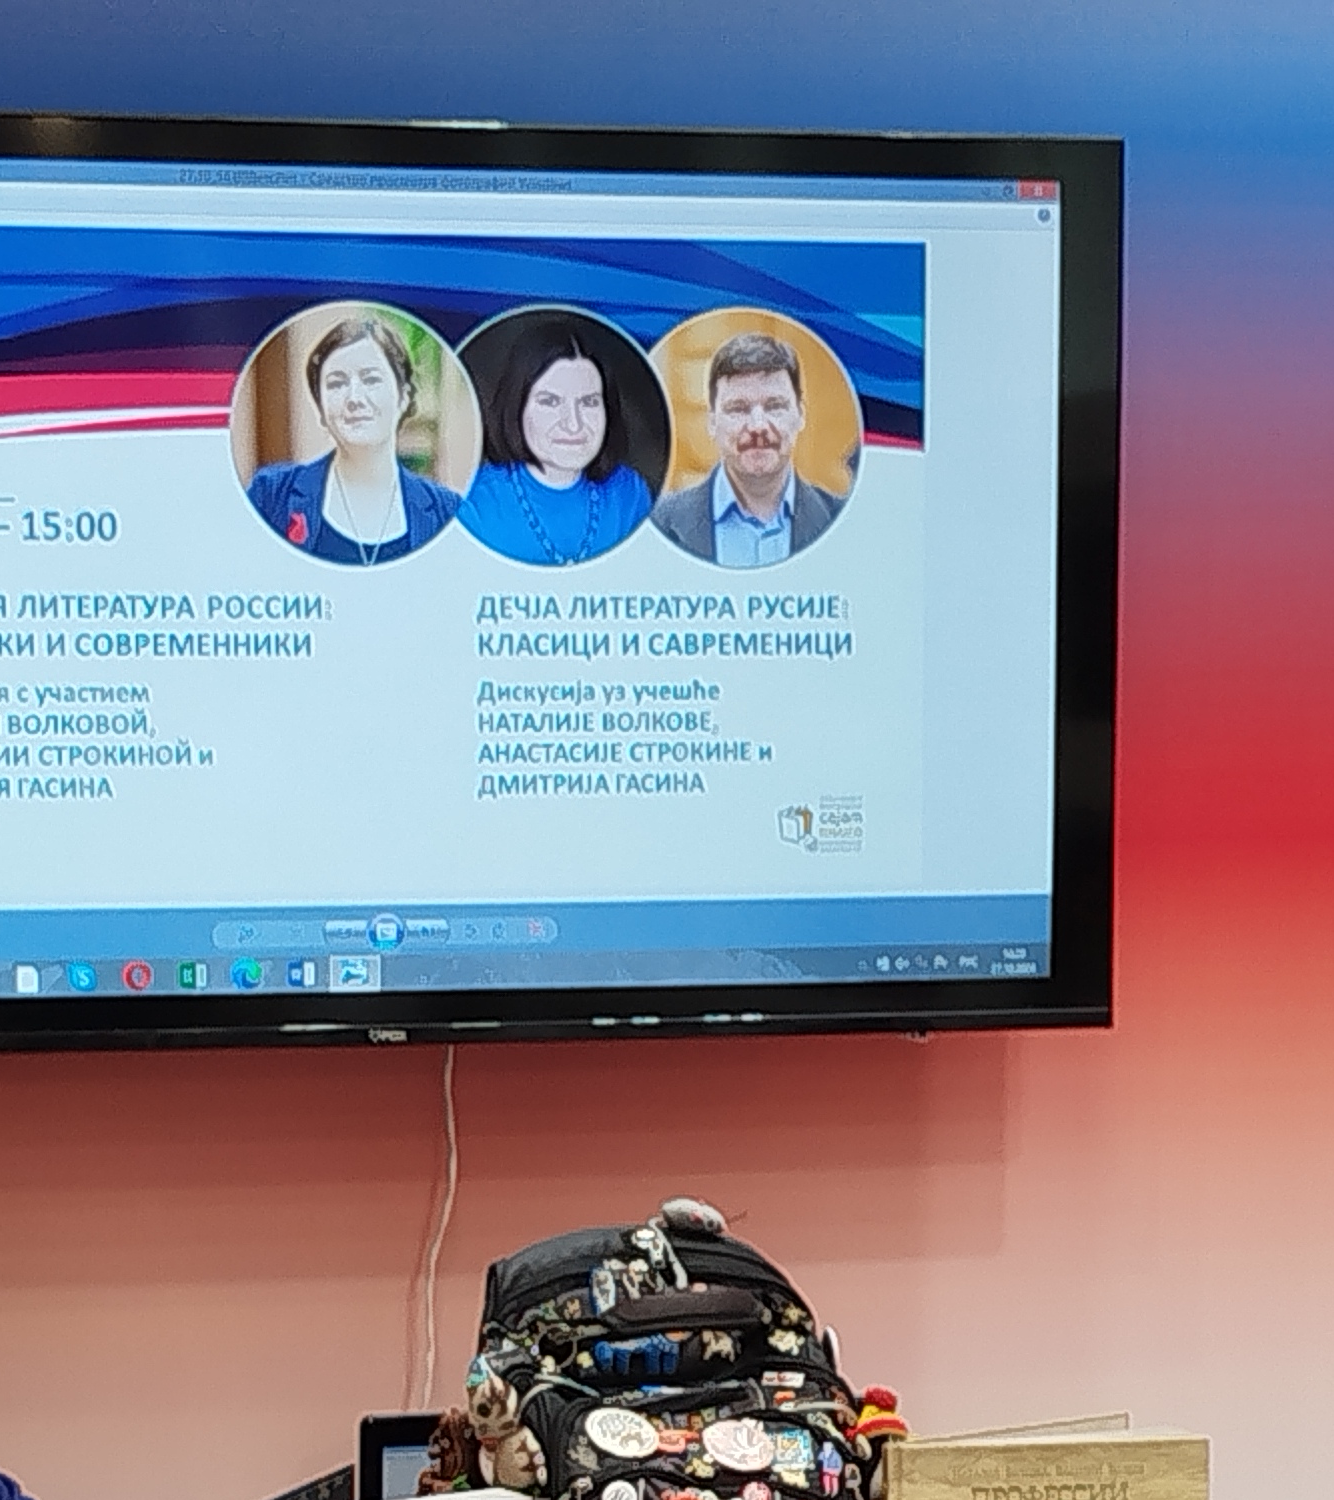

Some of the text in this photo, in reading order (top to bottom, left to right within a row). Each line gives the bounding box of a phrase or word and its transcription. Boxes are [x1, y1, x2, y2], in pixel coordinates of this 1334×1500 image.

[21, 510, 117, 541] 15:00
[18, 594, 195, 620] ЛИТЕРАТУРА
[207, 594, 332, 621] РОССИИ:
[477, 596, 561, 624] ДЕЧЈА
[569, 595, 736, 620] ЛИТЕРАТУРА
[47, 632, 65, 657] И
[75, 632, 312, 658] СОВРЕМЕННИКИ
[478, 632, 854, 661] КЛАСИЦИ И САВРЕМЕНИЦИ
[18, 687, 28, 703] с
[35, 687, 149, 708] участием
[477, 678, 720, 707] Дискусија уз учешће
[8, 709, 157, 739] ВОЛКОВОЙ,
[478, 712, 594, 734] НАТАЛИЈЕ
[38, 740, 192, 767] СТРОКИНОЙ
[199, 750, 213, 766] и
[478, 742, 773, 764] АНАСТАСИЈЕ СТРОКИНЕ и
[18, 777, 114, 799] ГАСИНА
[478, 773, 705, 799] ДМИТРИЈА ГАСИНА
